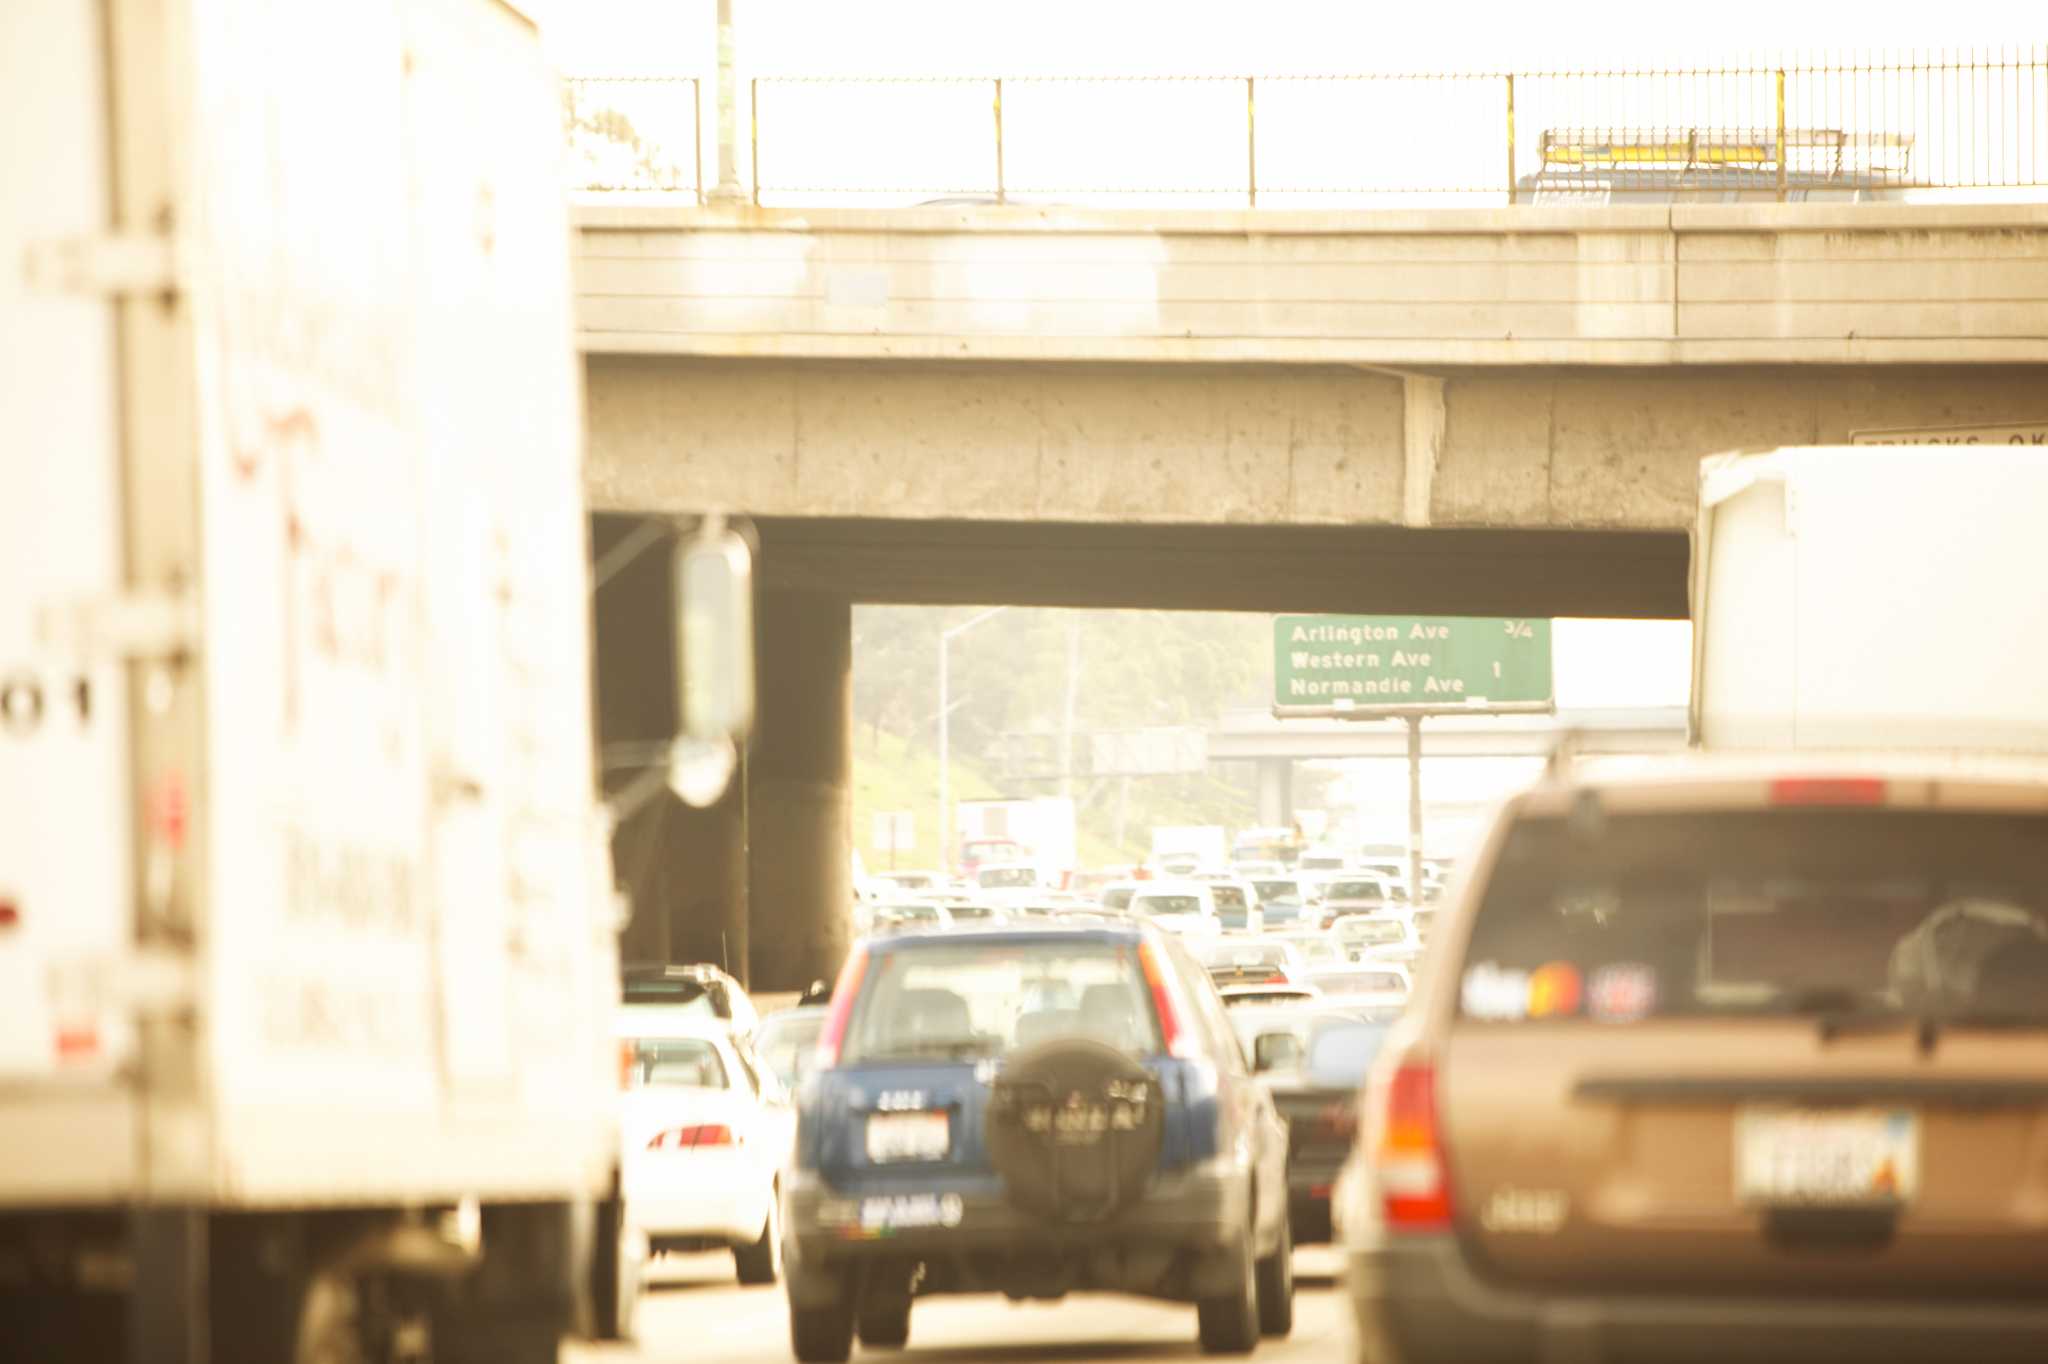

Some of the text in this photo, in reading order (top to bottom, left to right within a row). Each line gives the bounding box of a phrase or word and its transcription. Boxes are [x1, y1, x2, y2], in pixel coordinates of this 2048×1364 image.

[1291, 624, 1399, 646] Arlington
[1409, 623, 1449, 640] Ave
[1290, 650, 1502, 679] Western Ave 1
[1290, 676, 1464, 696] Normandie Ave
